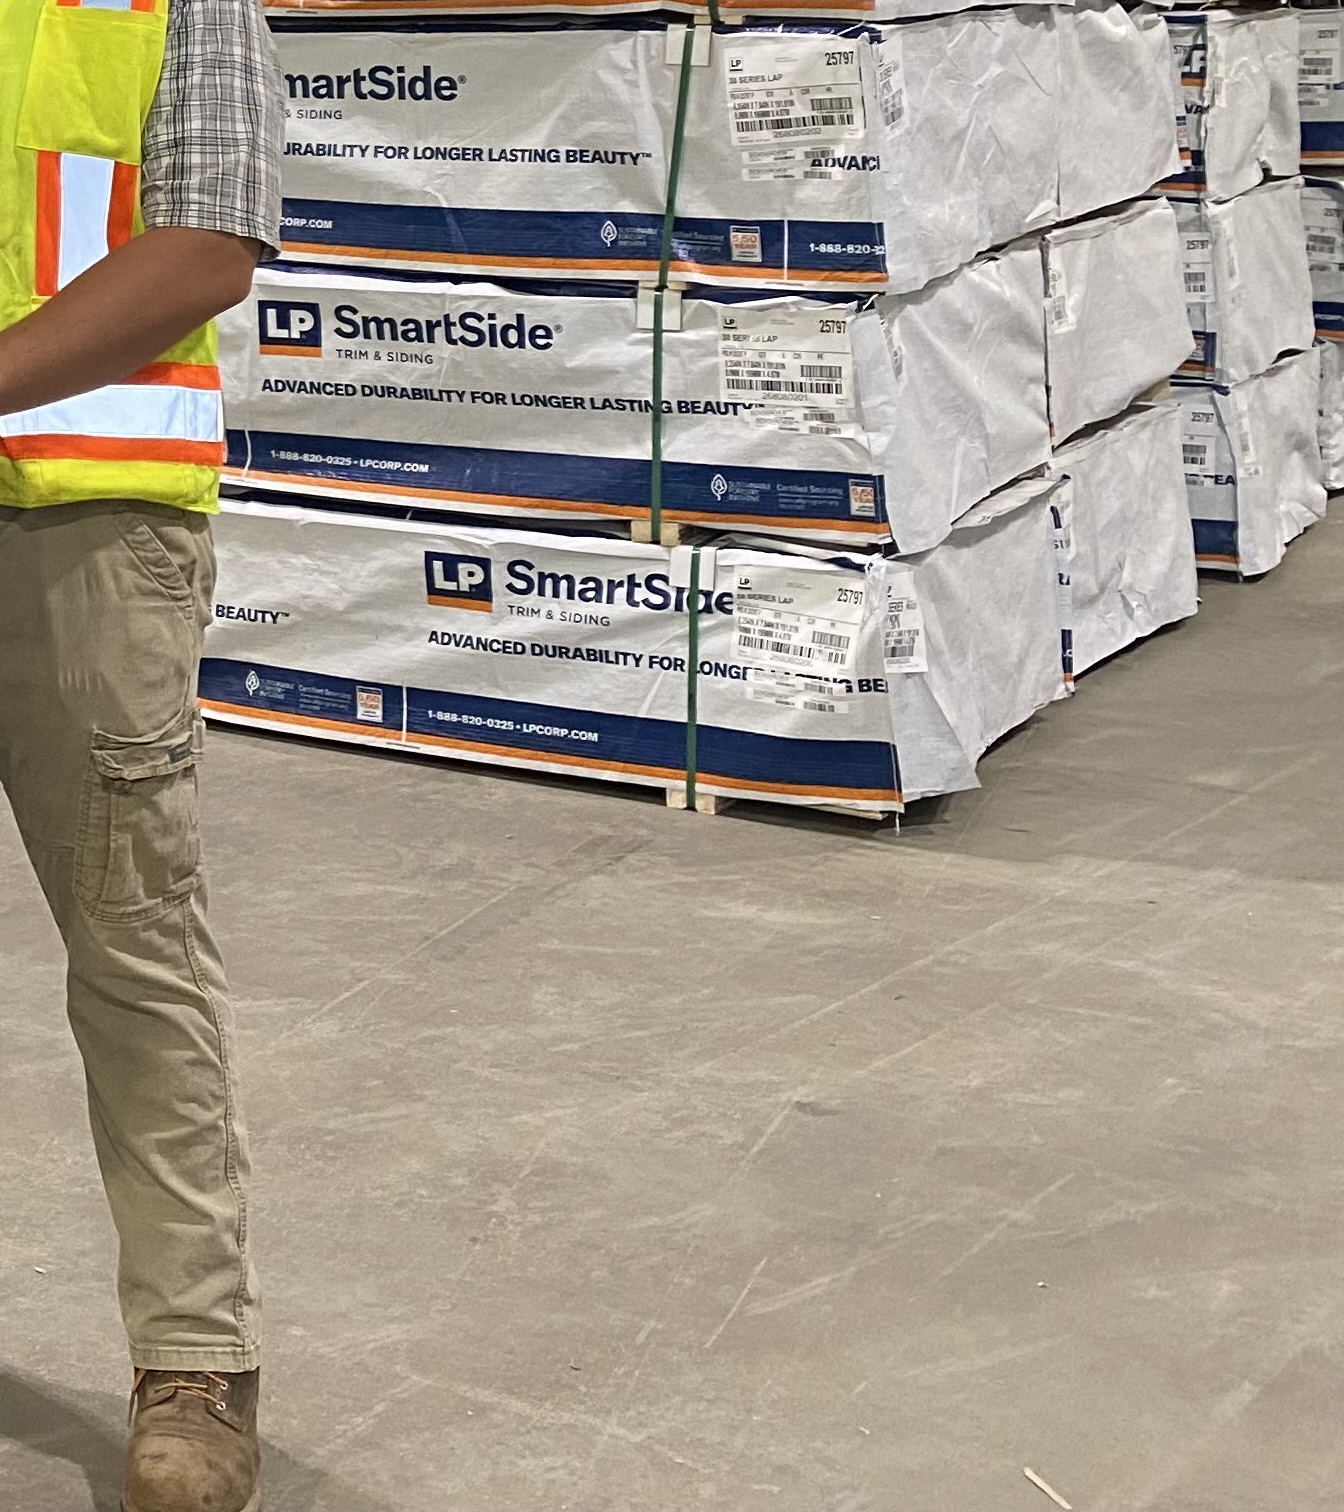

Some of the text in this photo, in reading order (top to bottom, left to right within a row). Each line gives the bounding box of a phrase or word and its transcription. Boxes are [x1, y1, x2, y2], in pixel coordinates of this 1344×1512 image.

[825, 50, 854, 66] 25797
[738, 73, 783, 84] SERIES LAP
[296, 108, 342, 120] SIDING
[373, 145, 561, 163] FOR LONGER LASTING
[266, 308, 314, 339] LP
[819, 320, 846, 334] 25797
[336, 349, 434, 365] TRIM SIDING
[261, 378, 673, 414] ADVANCED DURABILITY FOR LONGER LASTING
[270, 450, 430, 473] 1-888-820-0325 LPCORP.COM
[433, 561, 485, 592] LP
[837, 588, 864, 605] 25797
[508, 605, 610, 626] TRIM SIDING
[428, 630, 685, 672] ADVANCED DURABILITY FOR
[427, 710, 599, 742] 1-888-820-0325 LPCORP.COM
